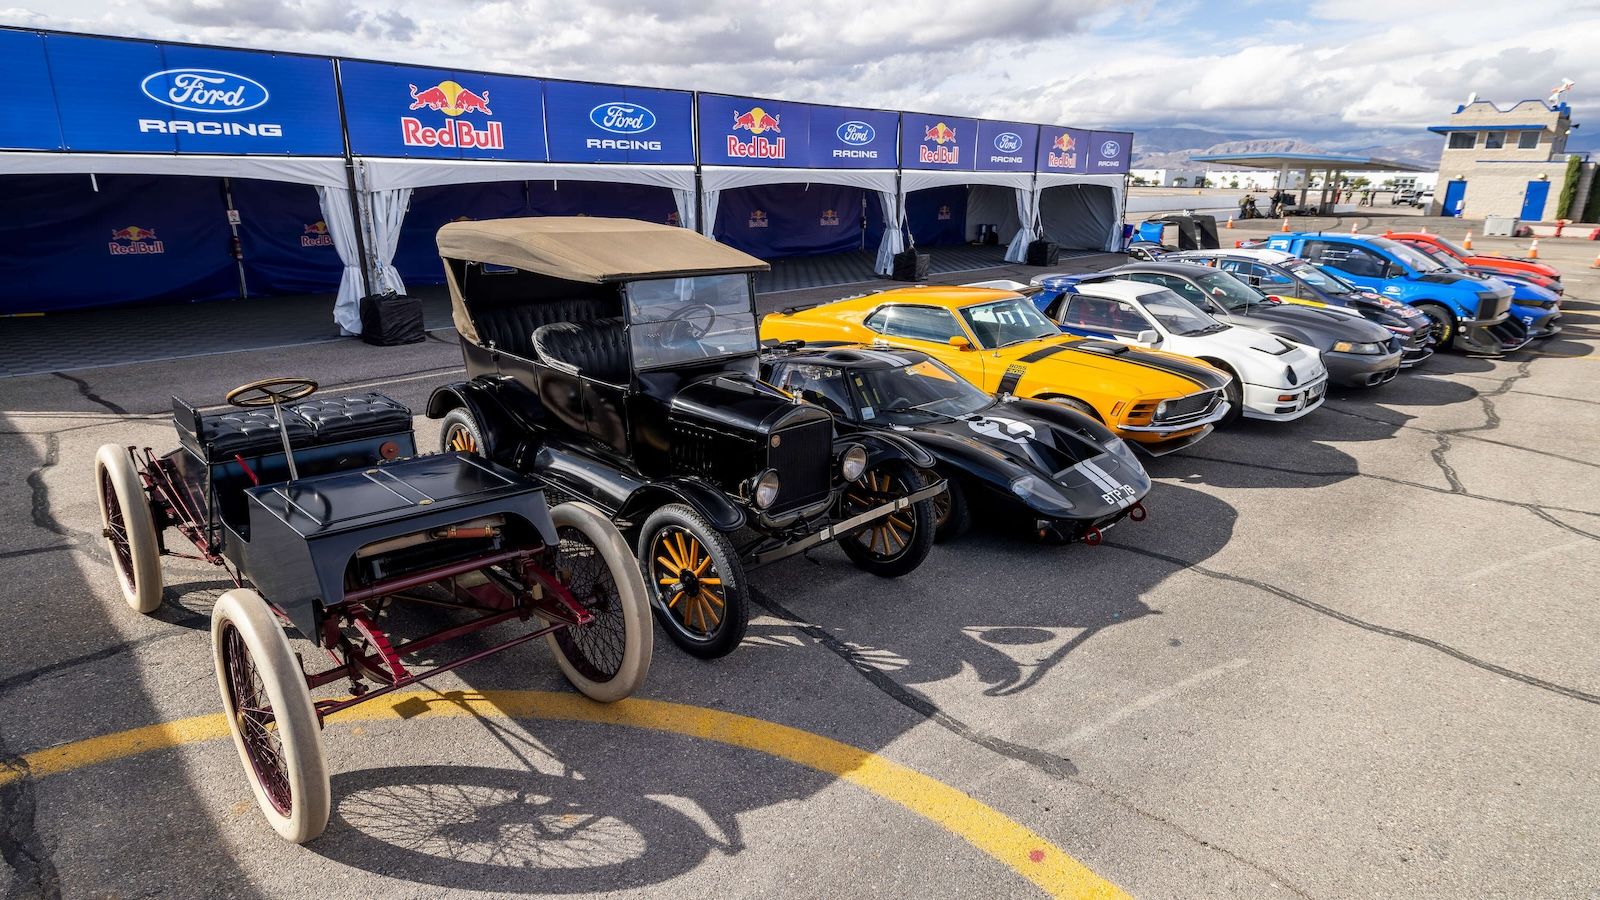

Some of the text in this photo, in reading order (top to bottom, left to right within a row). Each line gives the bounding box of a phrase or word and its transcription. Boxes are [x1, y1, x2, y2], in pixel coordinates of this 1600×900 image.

[169, 73, 246, 106] Ford
[603, 105, 644, 130] Ford
[138, 119, 283, 137] RACING
[401, 117, 504, 150] Red Bull
[844, 123, 868, 142] Ford
[586, 138, 662, 151] RACING
[727, 135, 786, 160] Red Bull
[1000, 134, 1018, 150] Ford
[1104, 142, 1117, 155] Ford
[832, 149, 878, 159] RACING
[920, 145, 959, 164] Red Bull
[1048, 151, 1077, 168] Red Bull
[109, 240, 164, 255] Red Bull
[1101, 489, 1123, 505] BTP
